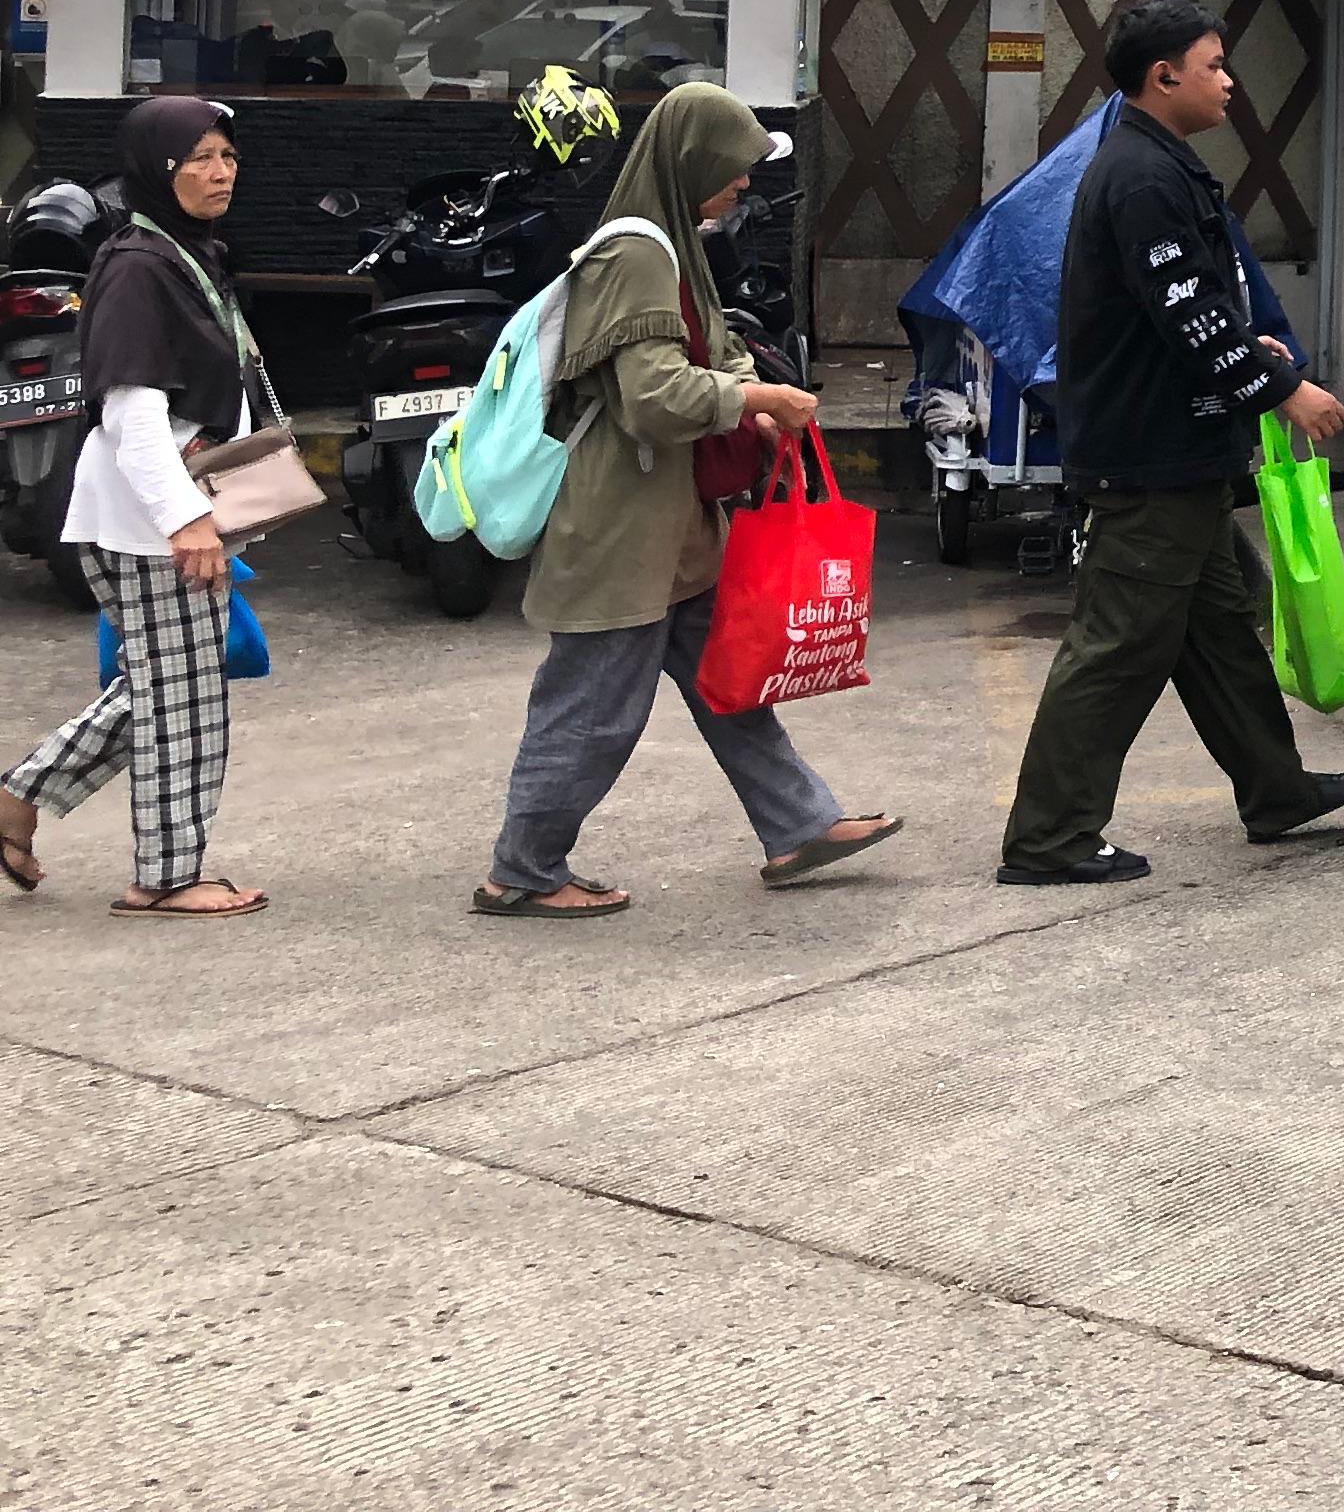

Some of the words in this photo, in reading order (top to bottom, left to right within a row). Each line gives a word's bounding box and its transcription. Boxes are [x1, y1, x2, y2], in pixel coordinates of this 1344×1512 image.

[378, 401, 388, 417] F
[401, 394, 443, 413] 4937
[788, 599, 836, 628] Lebih
[837, 594, 870, 622] Asik
[813, 623, 853, 643] TANPA
[784, 639, 858, 668] Kantong
[759, 660, 845, 704] Plastik
